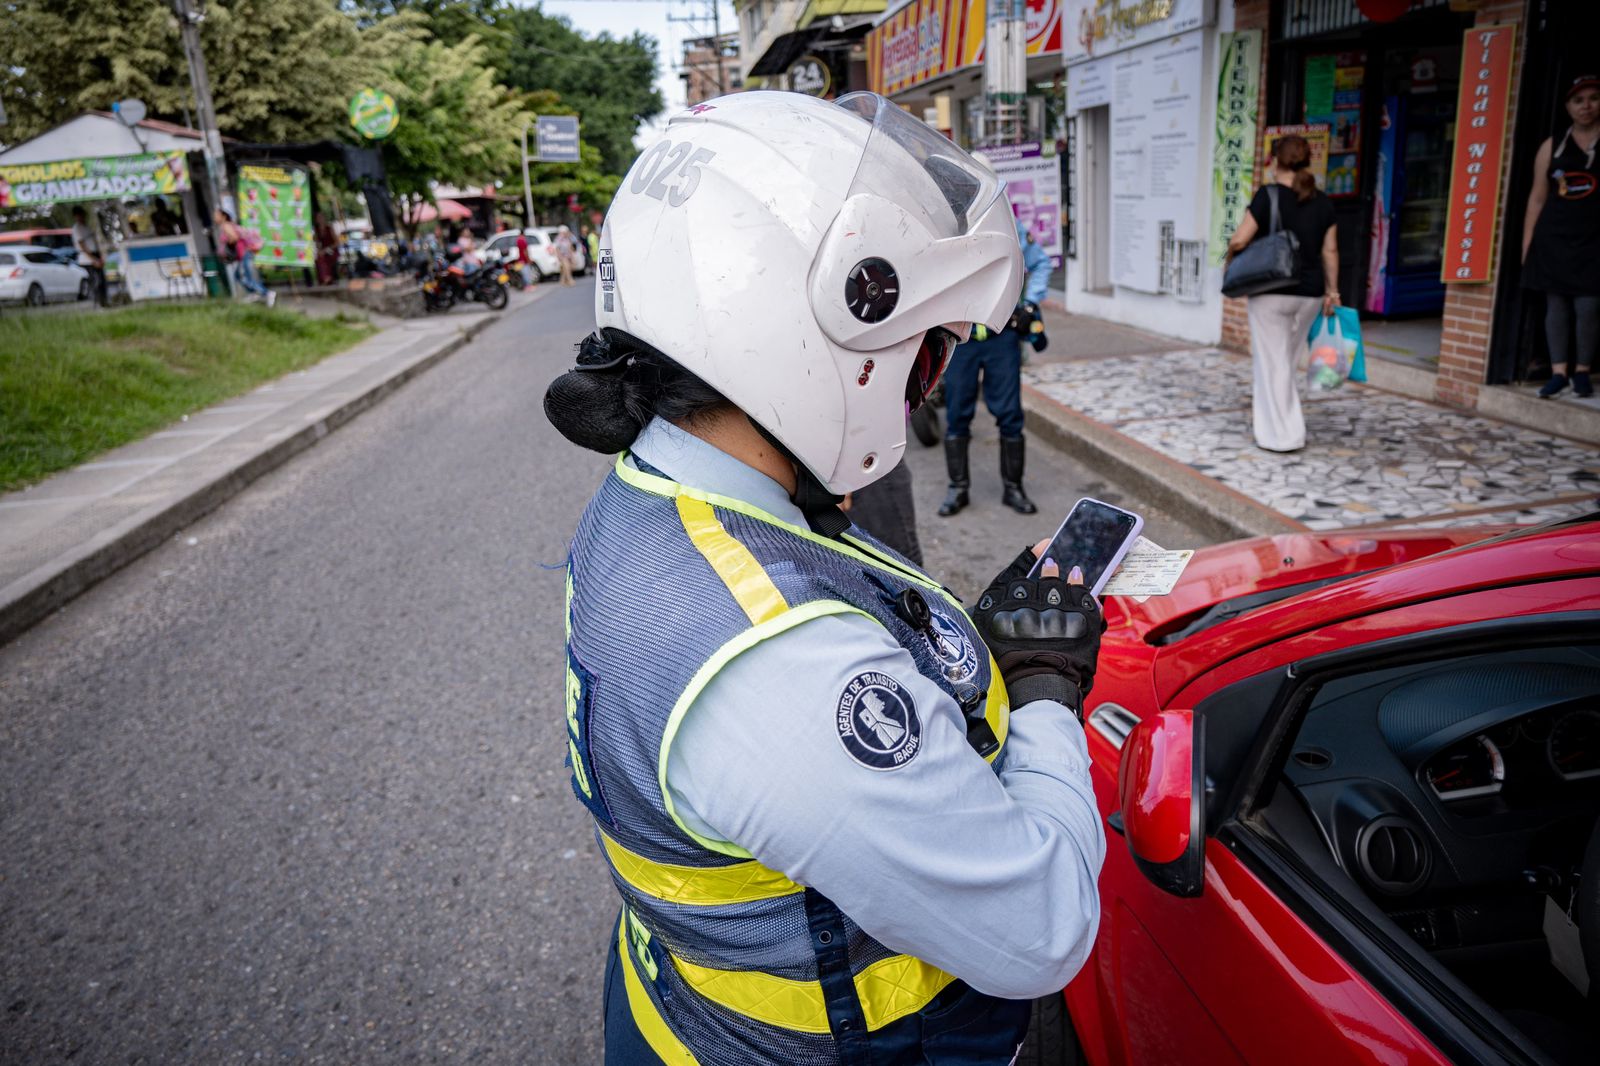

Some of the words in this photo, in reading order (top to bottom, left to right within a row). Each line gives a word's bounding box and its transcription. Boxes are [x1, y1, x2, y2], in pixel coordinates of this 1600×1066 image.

[1229, 36, 1250, 125] TIENDA
[16, 174, 156, 202] GRANIZADOS
[631, 139, 717, 208] 025
[1456, 143, 1487, 278] Naturista
[838, 692, 854, 737] AGENTES
[849, 678, 863, 694] DE
[861, 673, 898, 691] TRANSITO
[893, 734, 919, 764] IBAGUE
